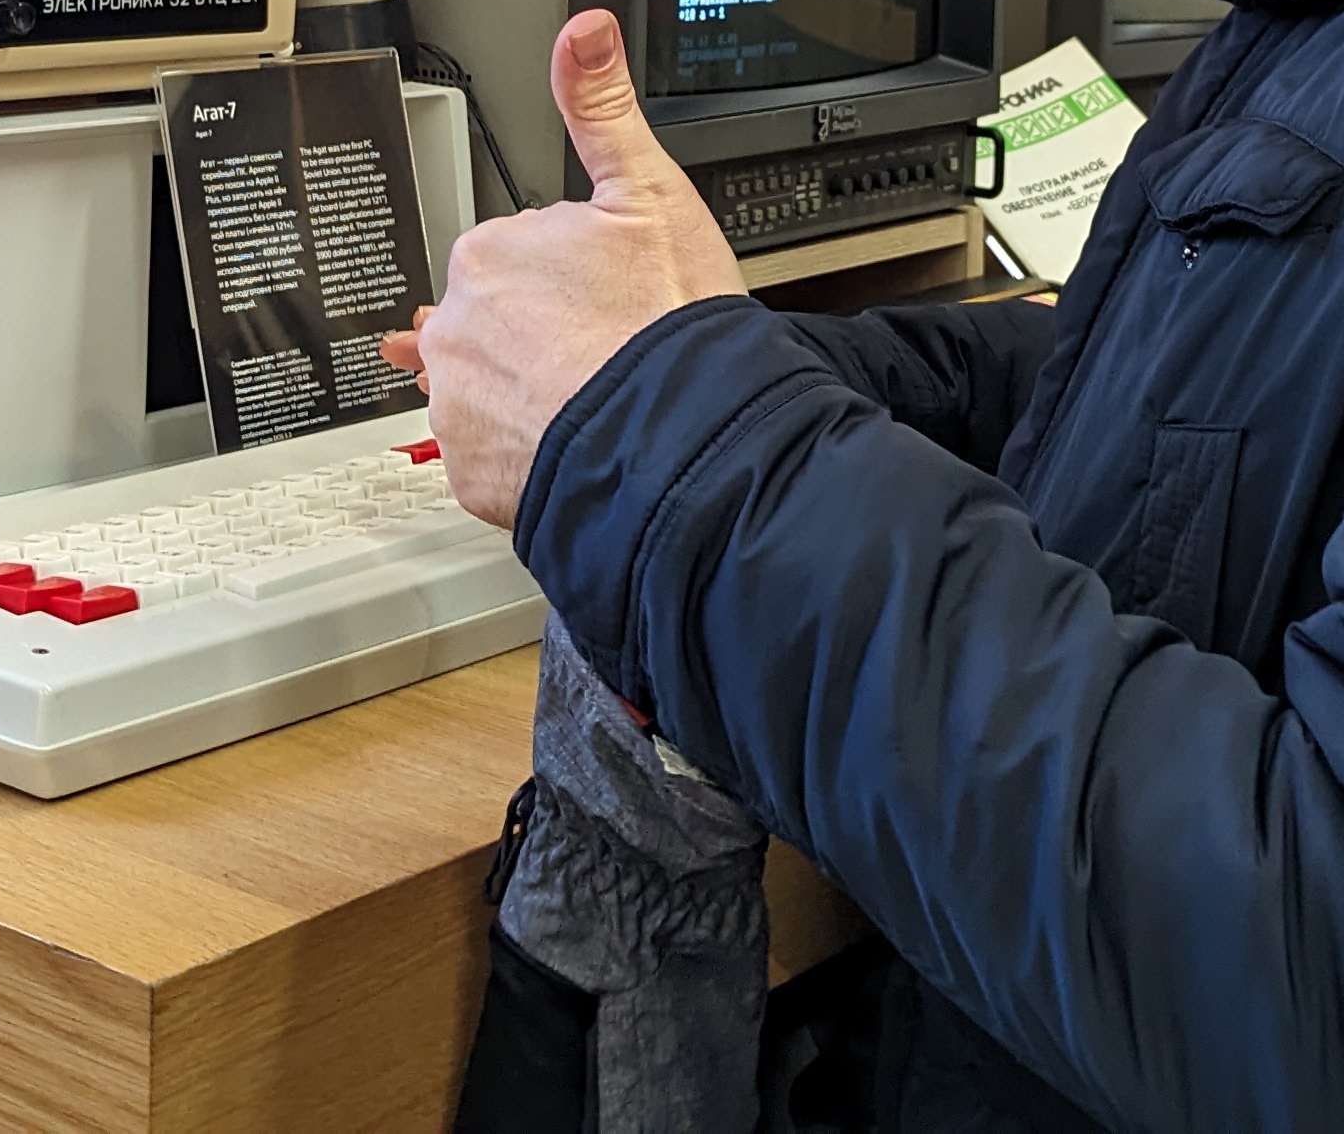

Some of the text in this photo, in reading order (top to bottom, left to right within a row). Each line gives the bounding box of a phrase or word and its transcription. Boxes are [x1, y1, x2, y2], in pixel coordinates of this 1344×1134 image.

[193, 101, 236, 124] Агат-7
[1019, 158, 1107, 197] ПРОГРАММНОЕ
[1001, 186, 1076, 214] ОБЕСПЕЧЕНИЕ
